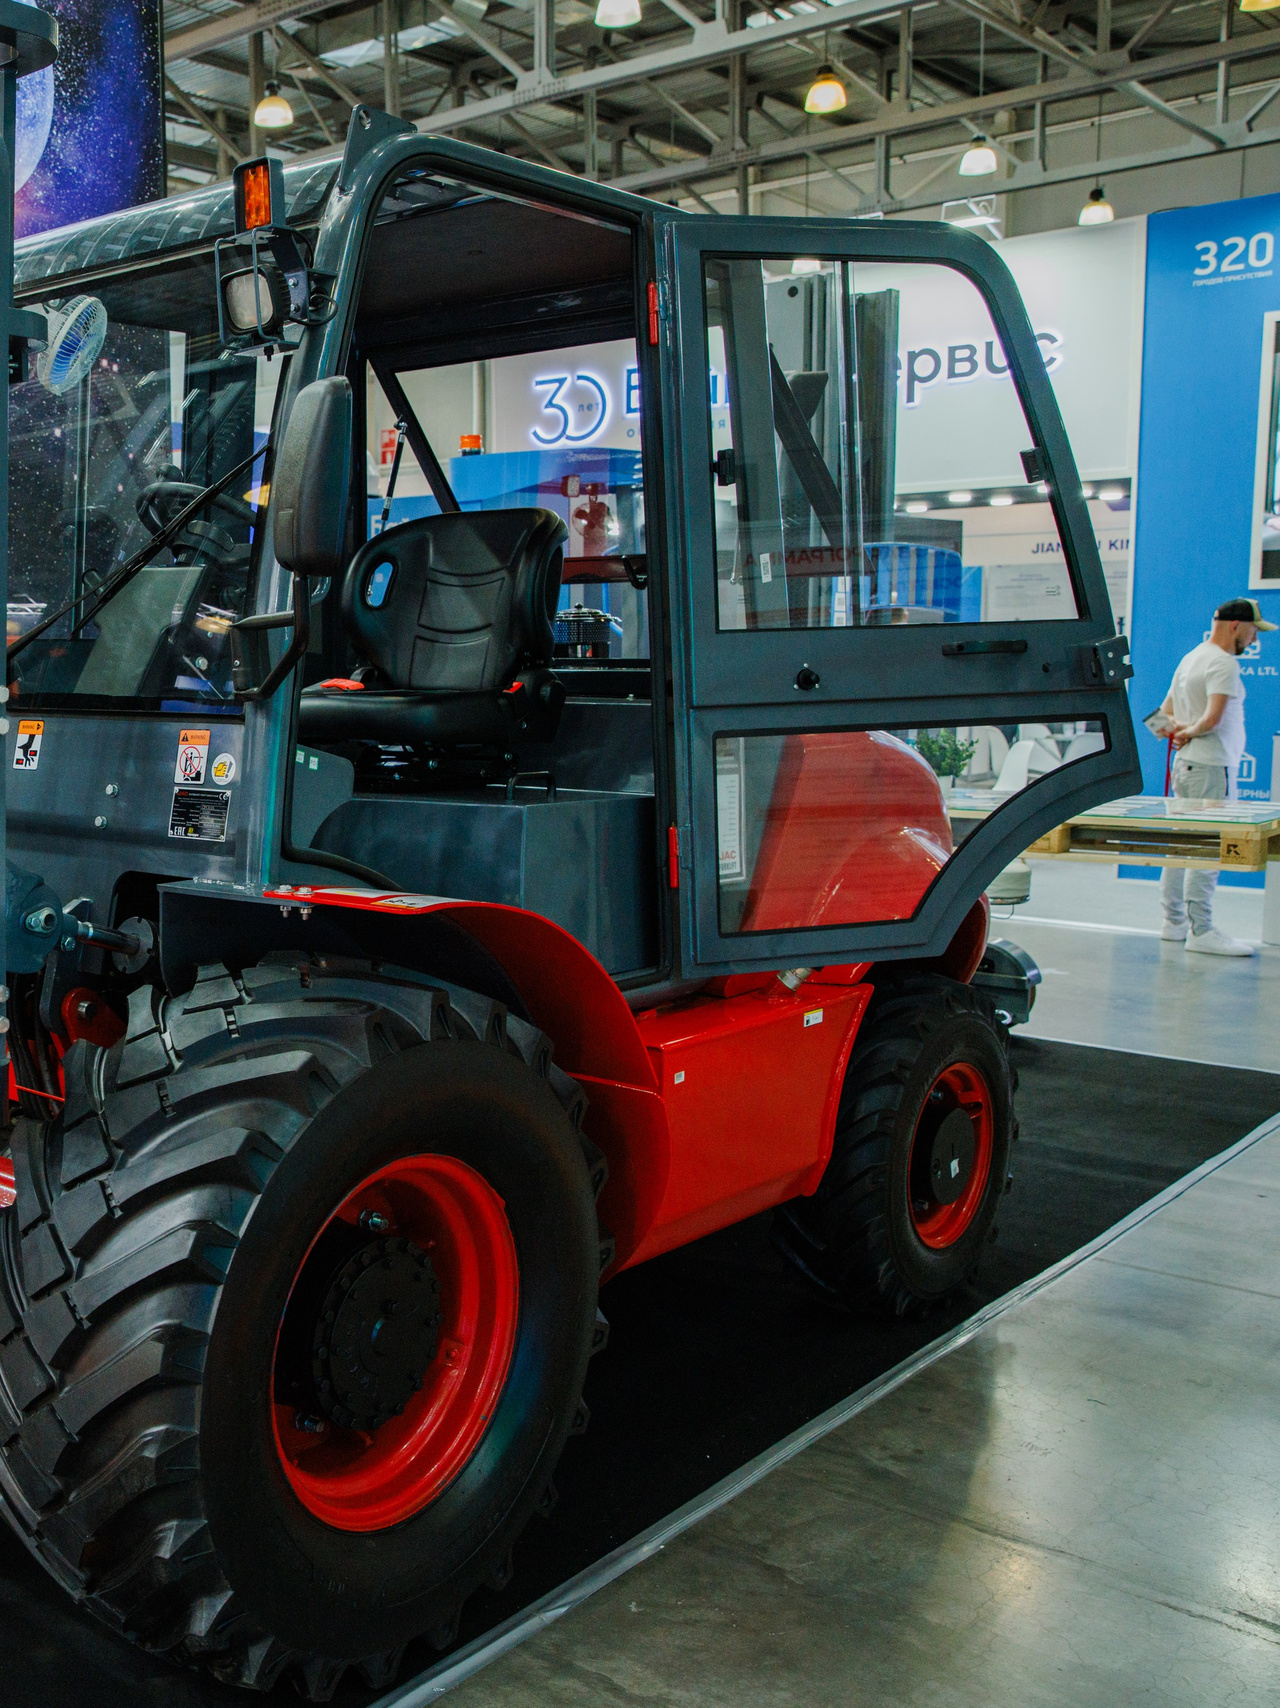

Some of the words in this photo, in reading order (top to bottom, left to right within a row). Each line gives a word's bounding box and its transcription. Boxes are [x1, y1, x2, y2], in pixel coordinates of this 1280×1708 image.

[1193, 231, 1274, 276] 320
[1192, 277, 1223, 287] ГОРОДОВ
[578, 402, 600, 413] лет
[1257, 666, 1279, 676] LTL
